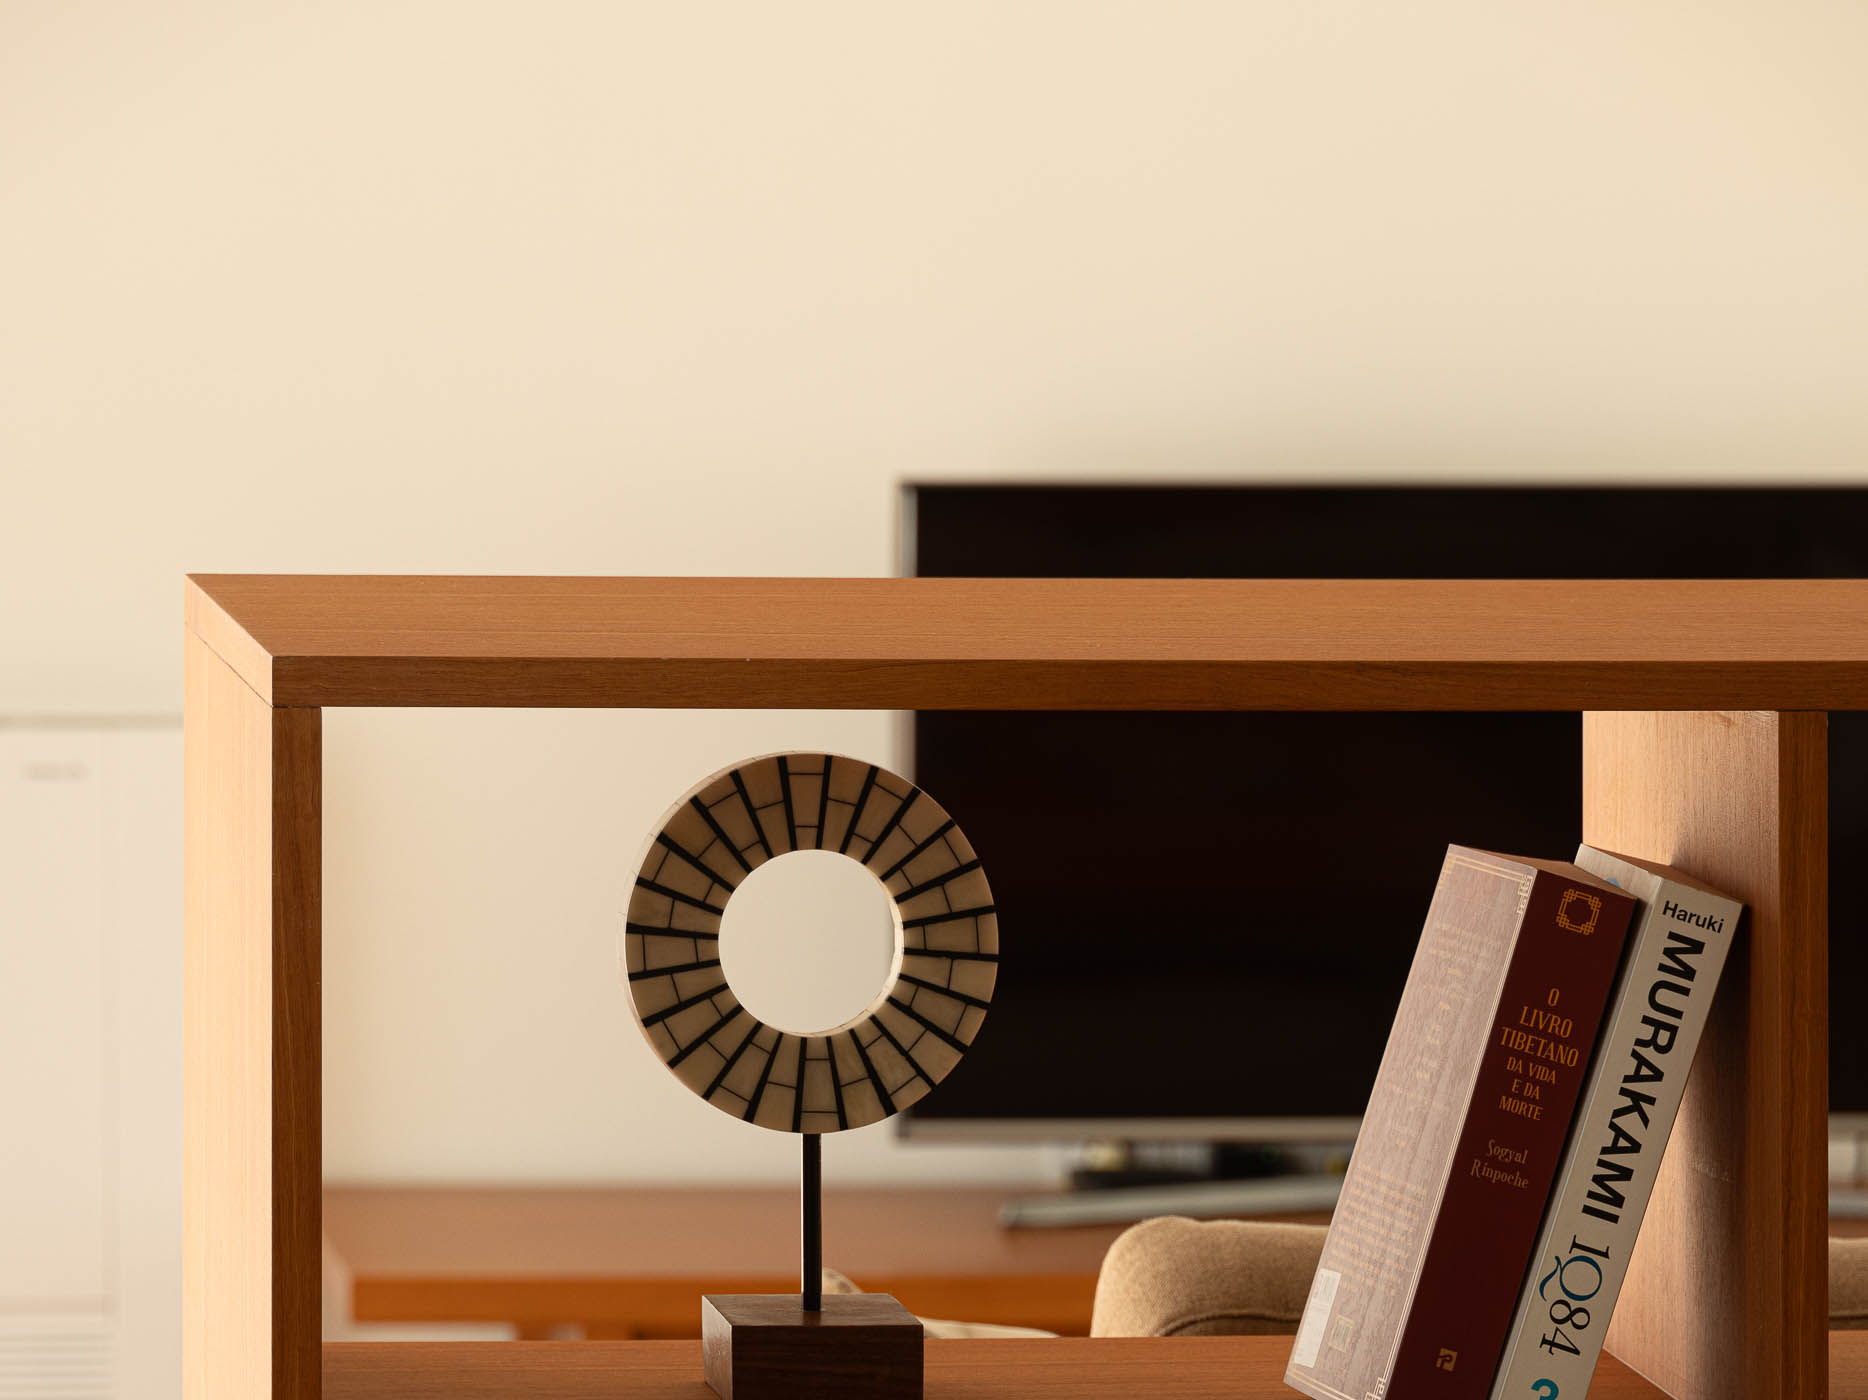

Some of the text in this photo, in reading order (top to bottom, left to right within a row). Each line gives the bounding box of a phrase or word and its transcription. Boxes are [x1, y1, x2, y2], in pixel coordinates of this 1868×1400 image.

[1662, 900, 1725, 934] Haruki
[1548, 988, 1560, 1007] O
[1519, 1005, 1573, 1039] LIVRO
[1500, 1026, 1580, 1068] TIBETANO
[1506, 1056, 1556, 1085] DA VIDA
[1581, 930, 1706, 1225] MURAKAMI
[1511, 1078, 1540, 1100] E DA
[1499, 1095, 1544, 1121] MORTE
[1487, 1139, 1529, 1164] Sogyal
[1470, 1159, 1529, 1189] Rinpoche
[1539, 1234, 1611, 1357] 1Q84
